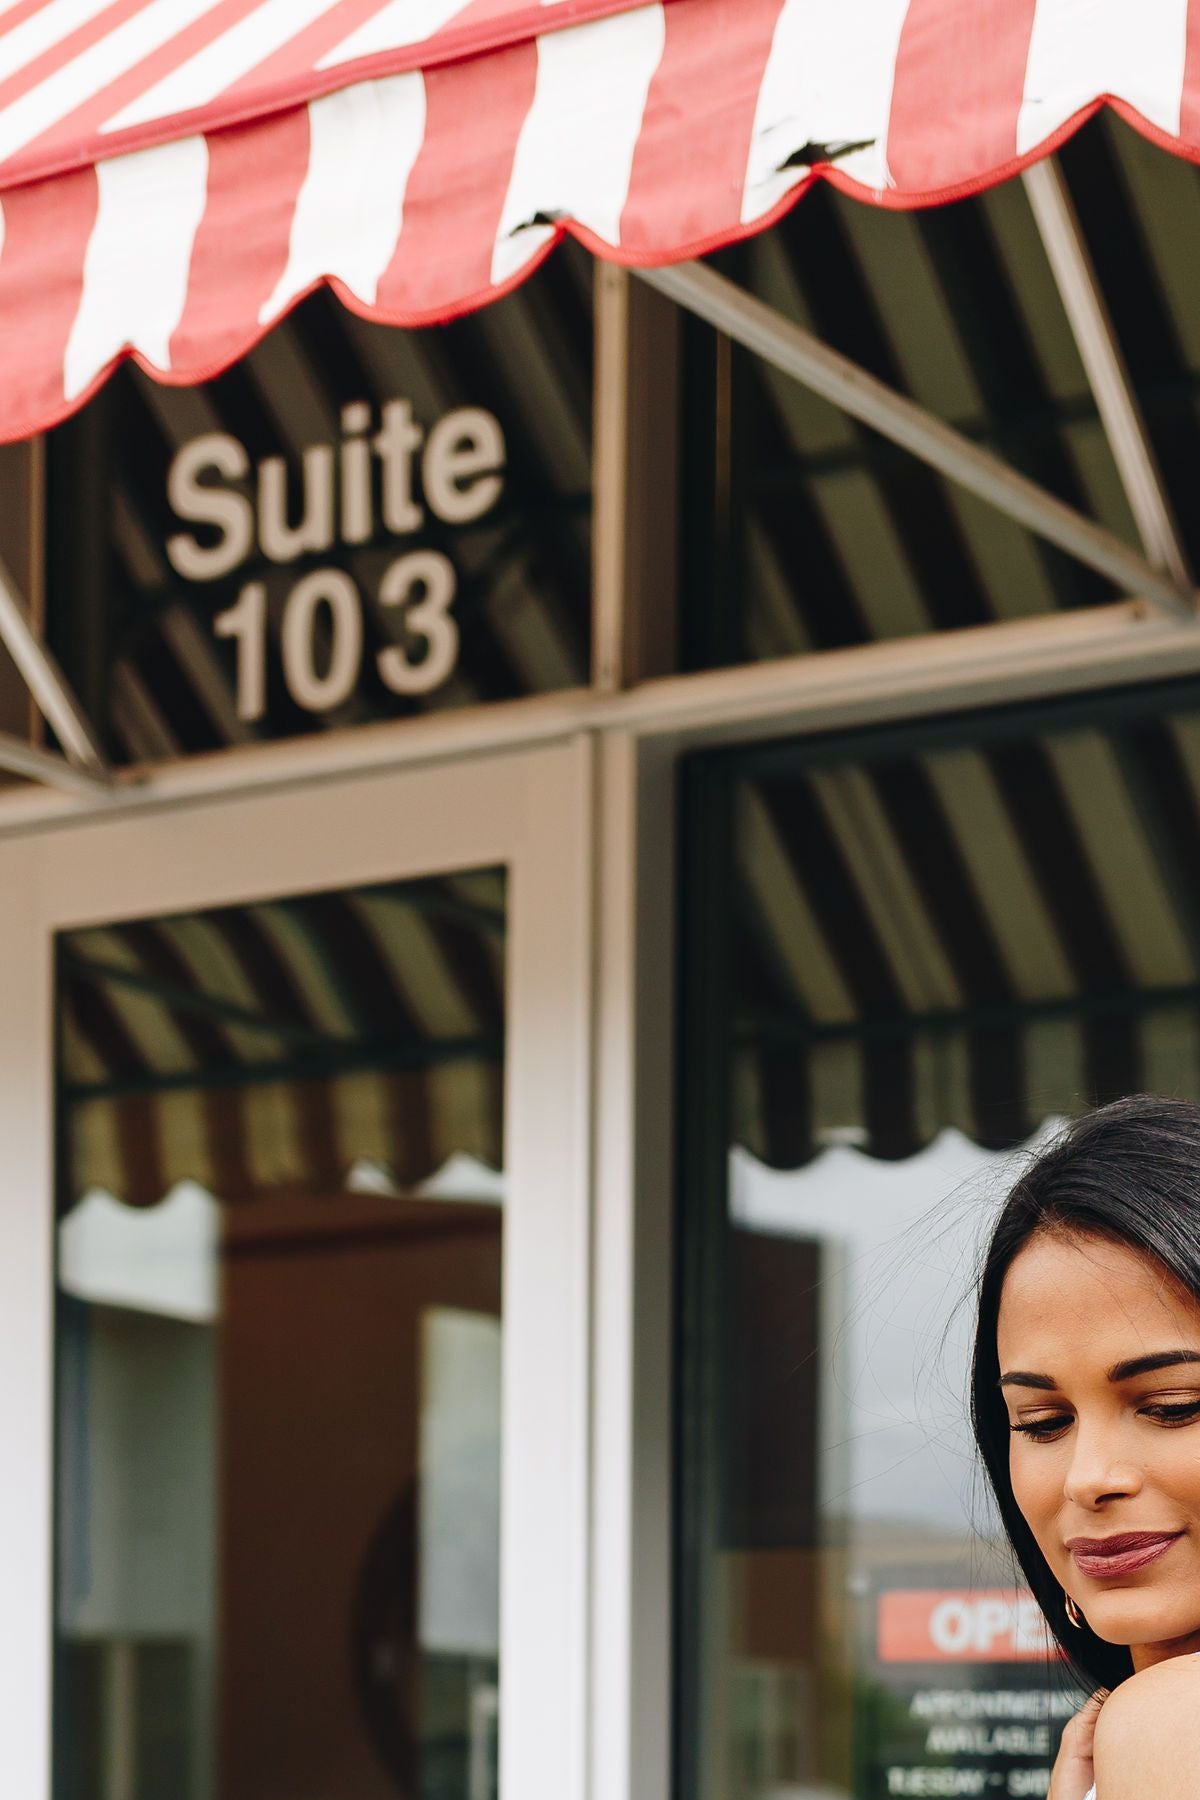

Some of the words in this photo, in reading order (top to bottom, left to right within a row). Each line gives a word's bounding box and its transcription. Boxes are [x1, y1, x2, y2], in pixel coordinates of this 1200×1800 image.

[166, 400, 506, 582] Suite
[213, 550, 460, 722] 103
[929, 1597, 1055, 1653] OPE
